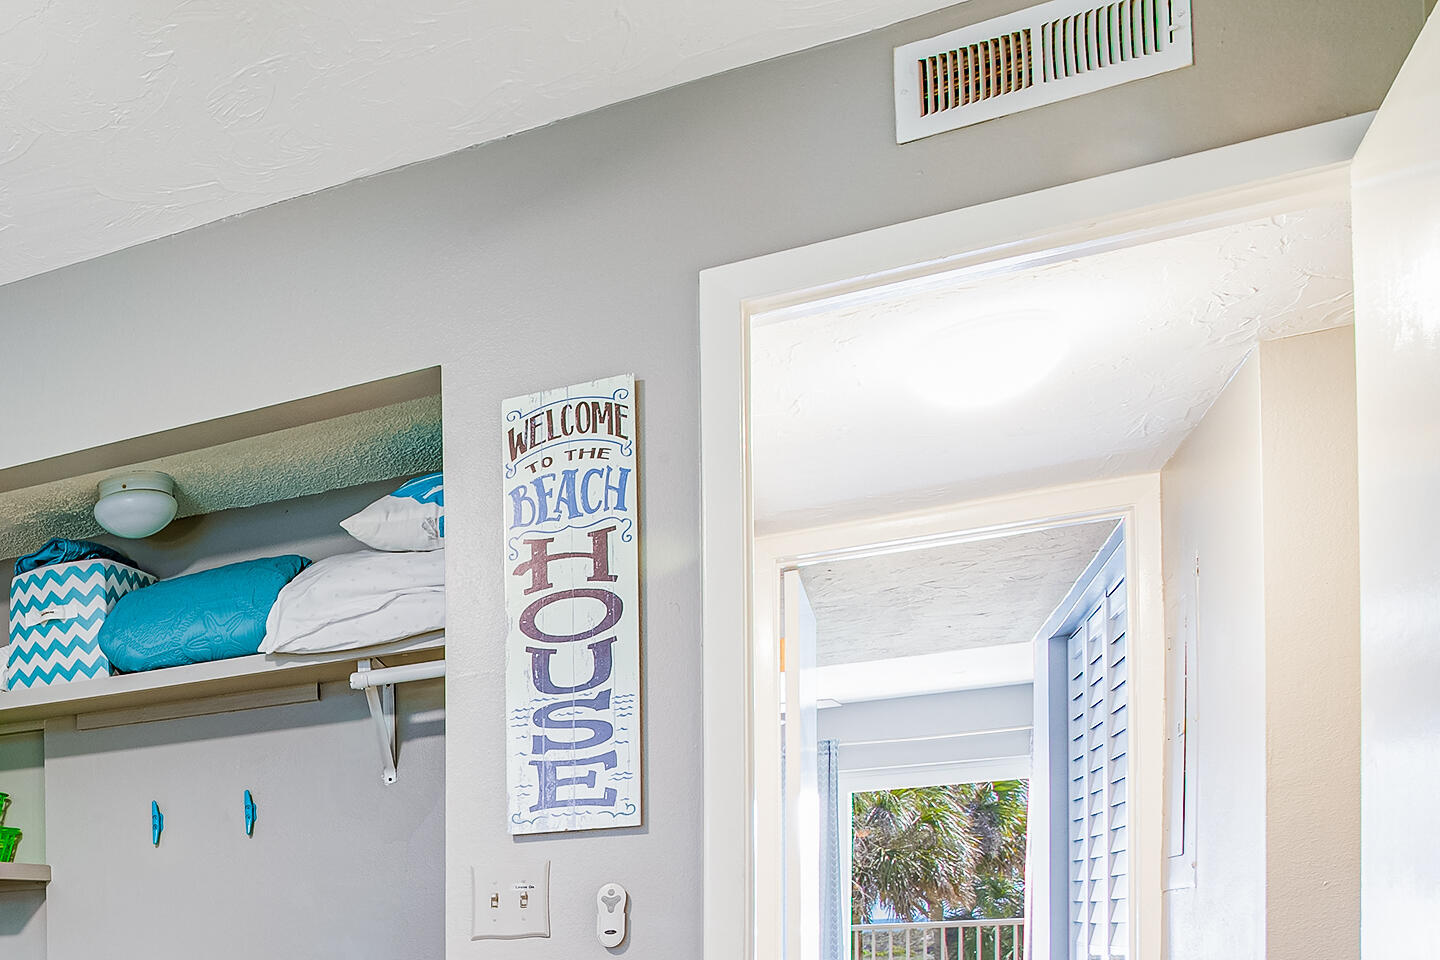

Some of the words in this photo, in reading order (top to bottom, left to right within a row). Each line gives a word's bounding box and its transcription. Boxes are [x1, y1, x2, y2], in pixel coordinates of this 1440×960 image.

[507, 401, 629, 463] WELCOME
[525, 457, 554, 475] TO
[564, 447, 612, 466] THE
[508, 467, 632, 531] BEACH
[512, 525, 624, 813] HOUSE
